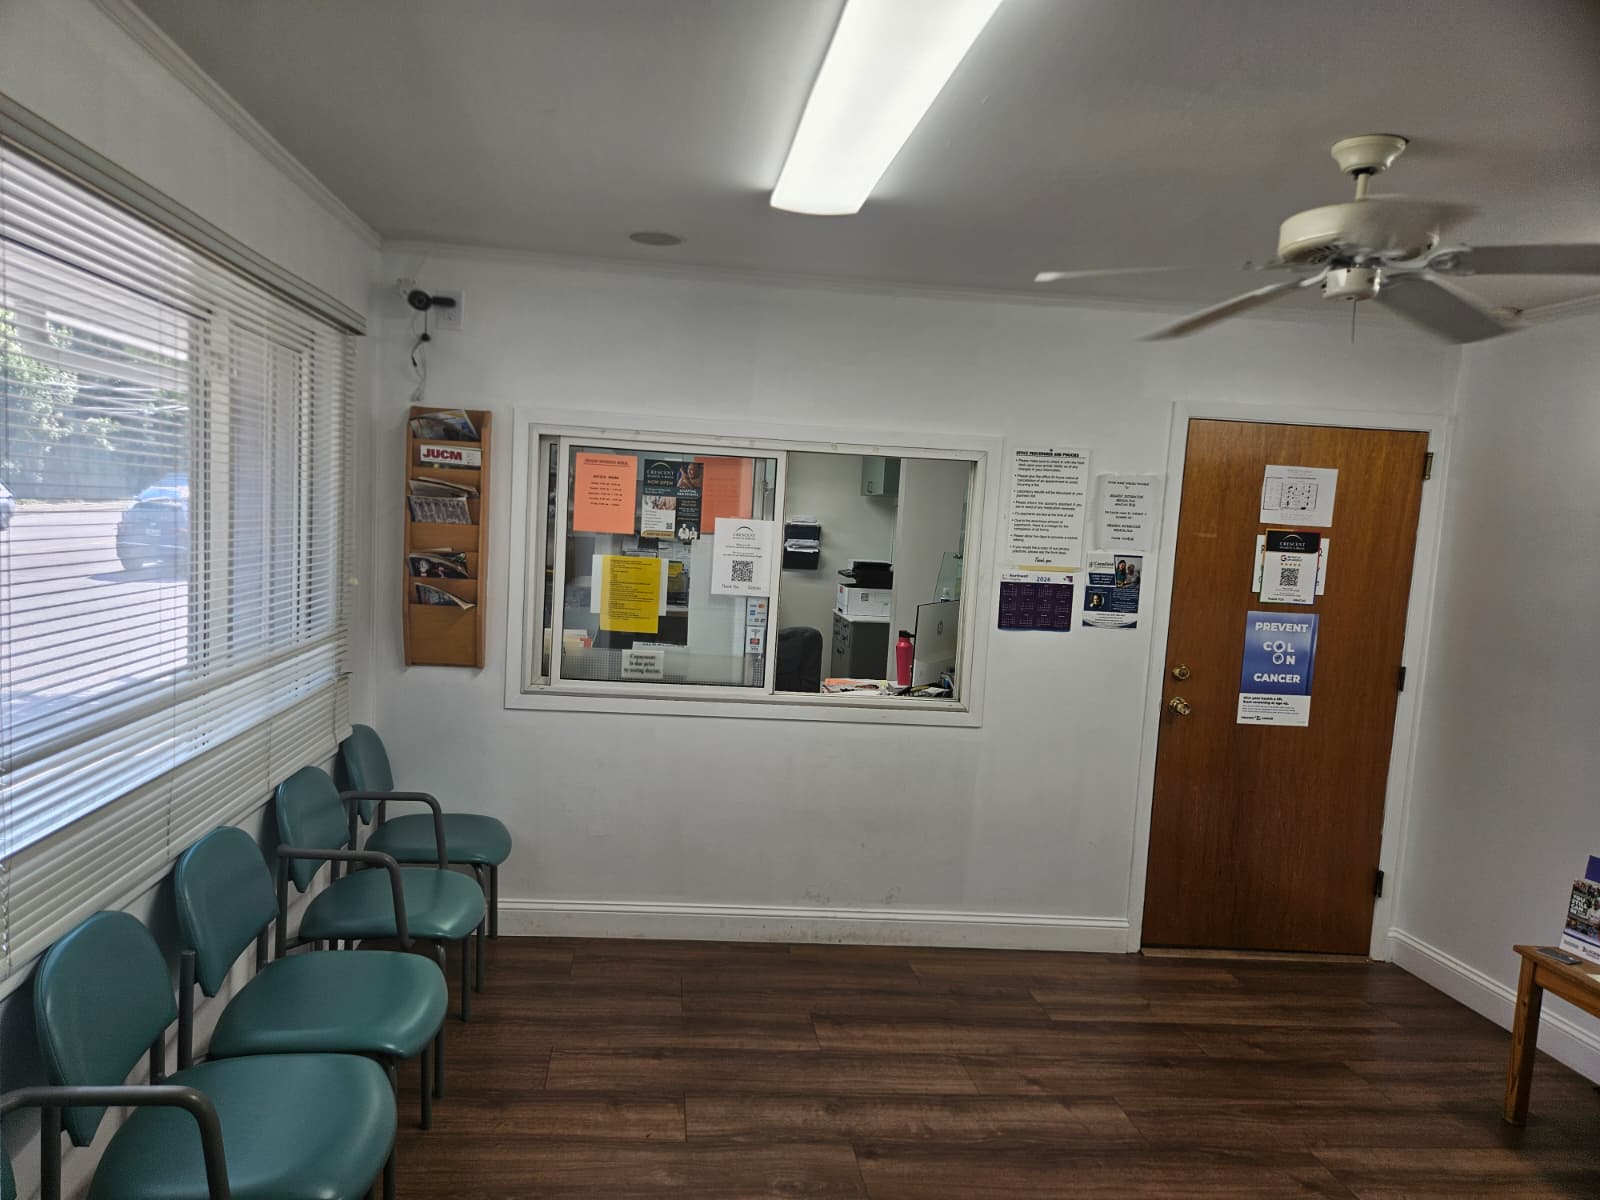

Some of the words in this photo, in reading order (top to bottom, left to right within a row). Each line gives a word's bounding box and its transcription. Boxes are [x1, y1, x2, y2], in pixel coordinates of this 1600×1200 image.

[422, 448, 463, 461] JUCM
[1255, 622, 1309, 633] PREVENT
[1253, 672, 1301, 684] CANCER
